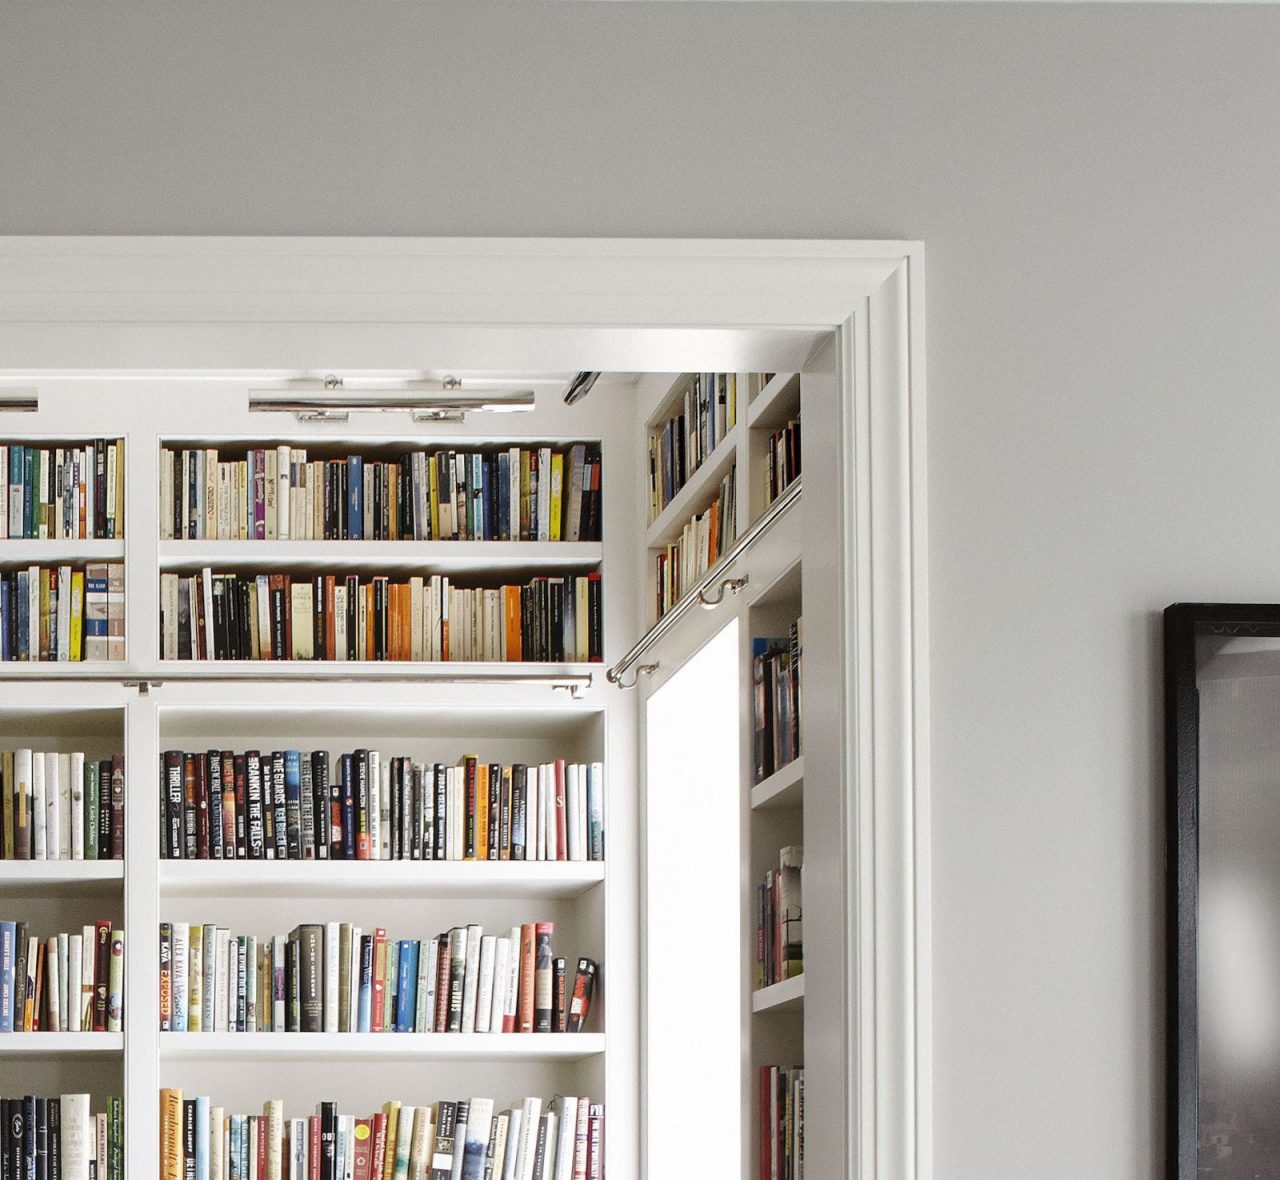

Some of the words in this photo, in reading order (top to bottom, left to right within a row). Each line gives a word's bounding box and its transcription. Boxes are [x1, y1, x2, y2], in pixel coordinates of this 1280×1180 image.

[273, 759, 283, 772] THE
[170, 766, 182, 803] THRILLER
[249, 763, 260, 800] RANKIN
[274, 773, 284, 804] GUARDS
[249, 803, 261, 818] THE
[275, 807, 285, 822] KEN
[304, 806, 313, 817] THE
[250, 820, 262, 847] FALLS
[174, 938, 183, 957] ALEX
[174, 959, 183, 979] KAVA
[161, 969, 170, 1015] EXPOSED
[167, 1094, 179, 1170] Rembrandt's
